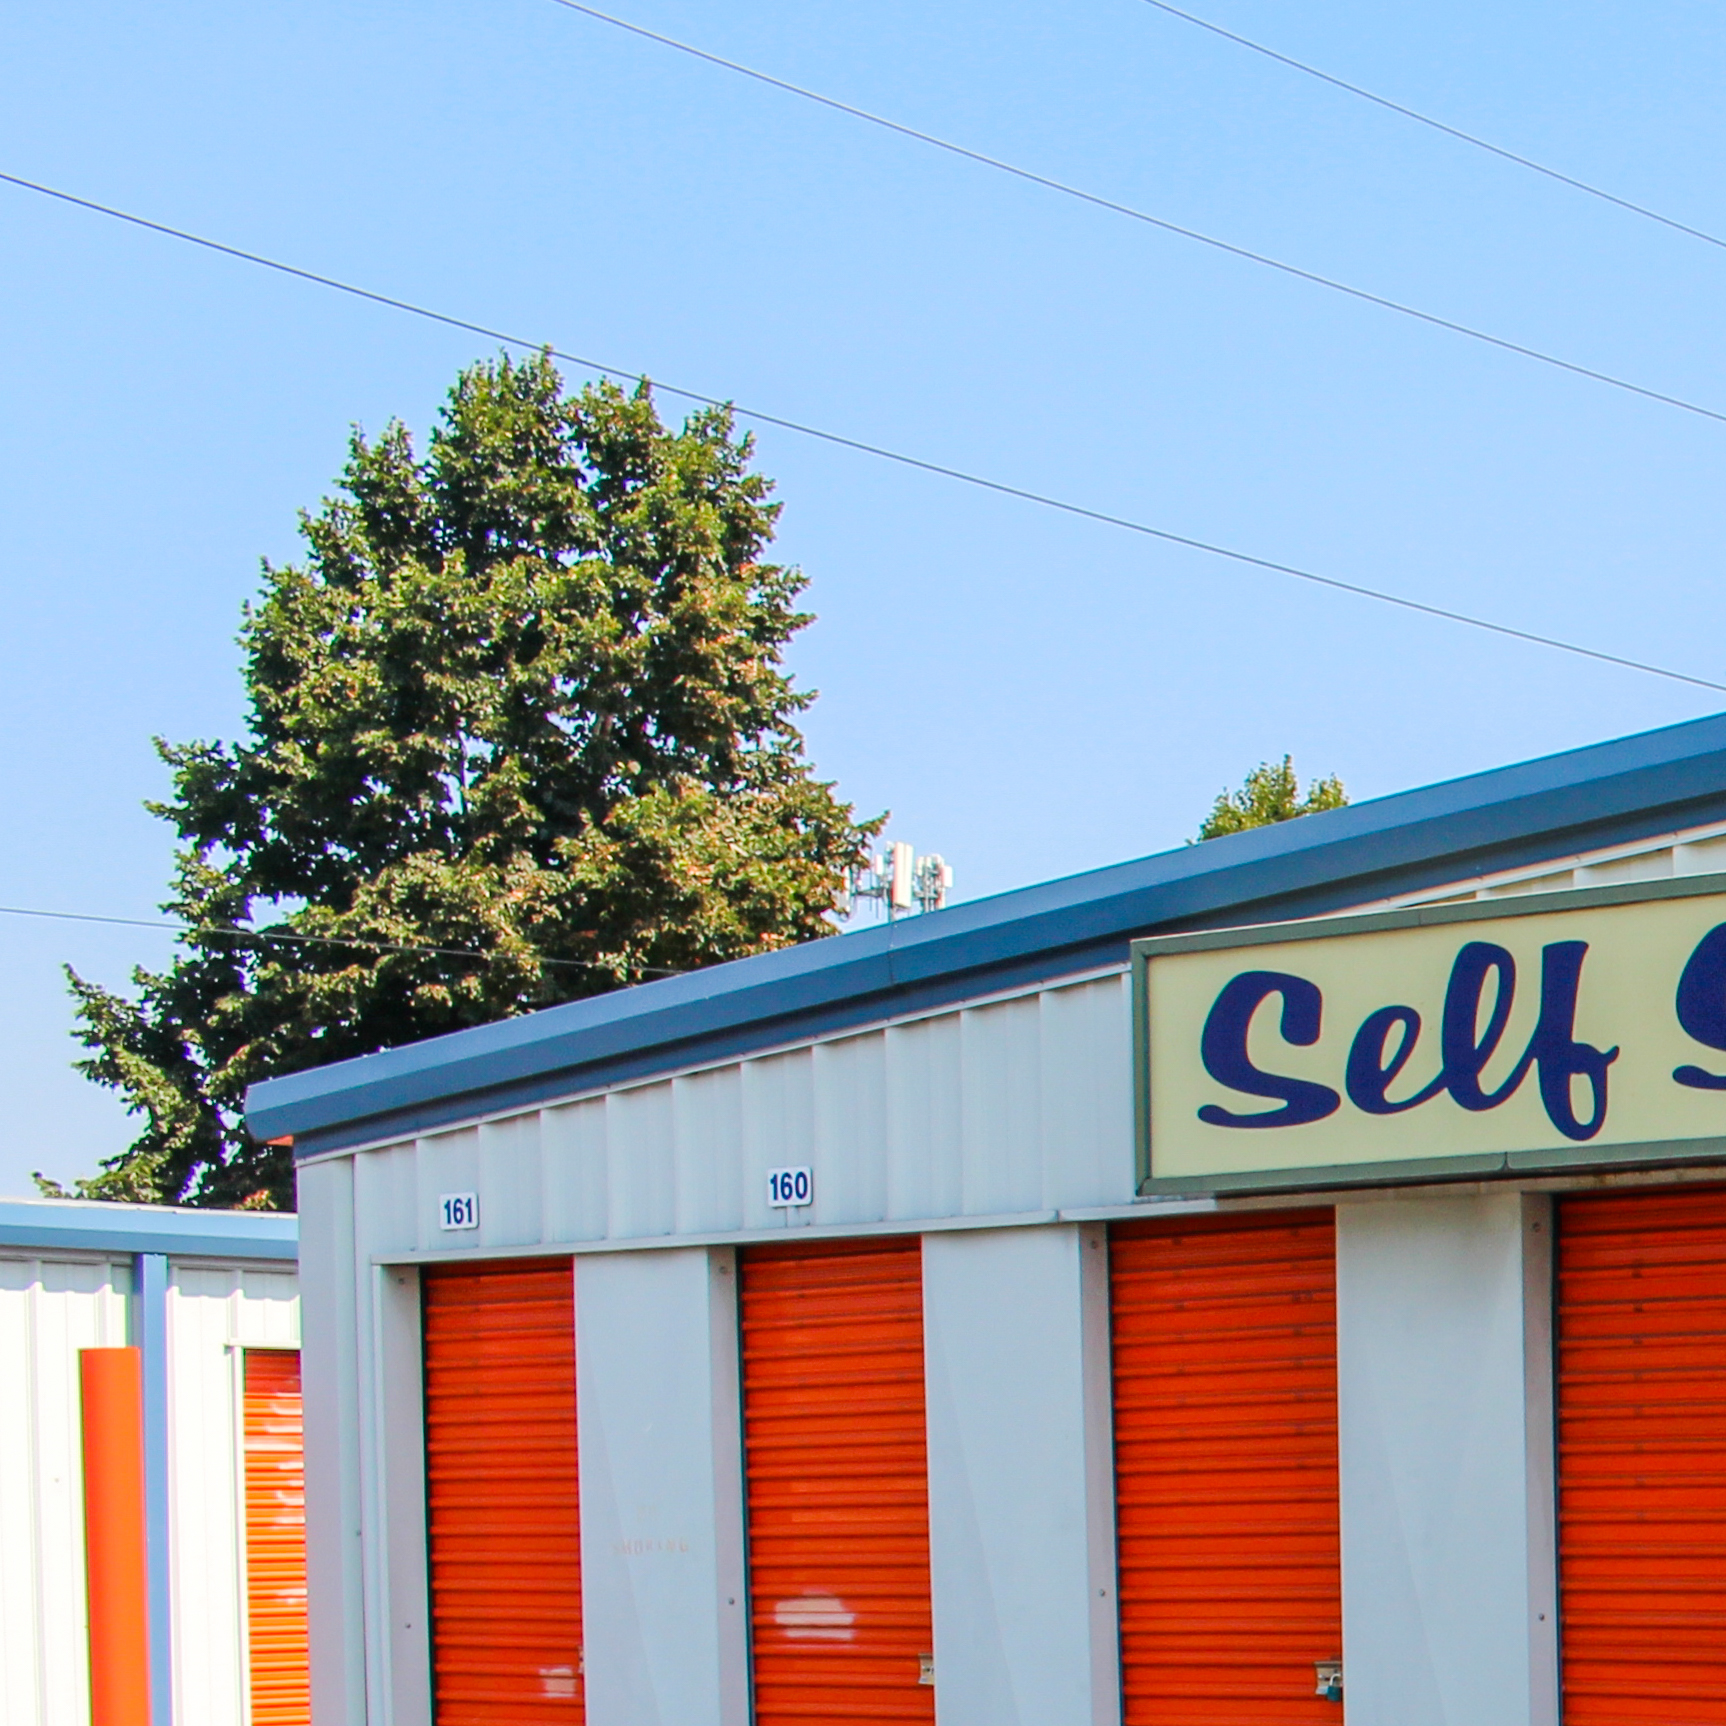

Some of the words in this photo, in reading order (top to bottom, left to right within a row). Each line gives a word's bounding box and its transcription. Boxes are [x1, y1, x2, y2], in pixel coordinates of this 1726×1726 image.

[1197, 939, 1619, 1141] Self
[770, 1172, 808, 1200] 160
[444, 1198, 473, 1225] 161
